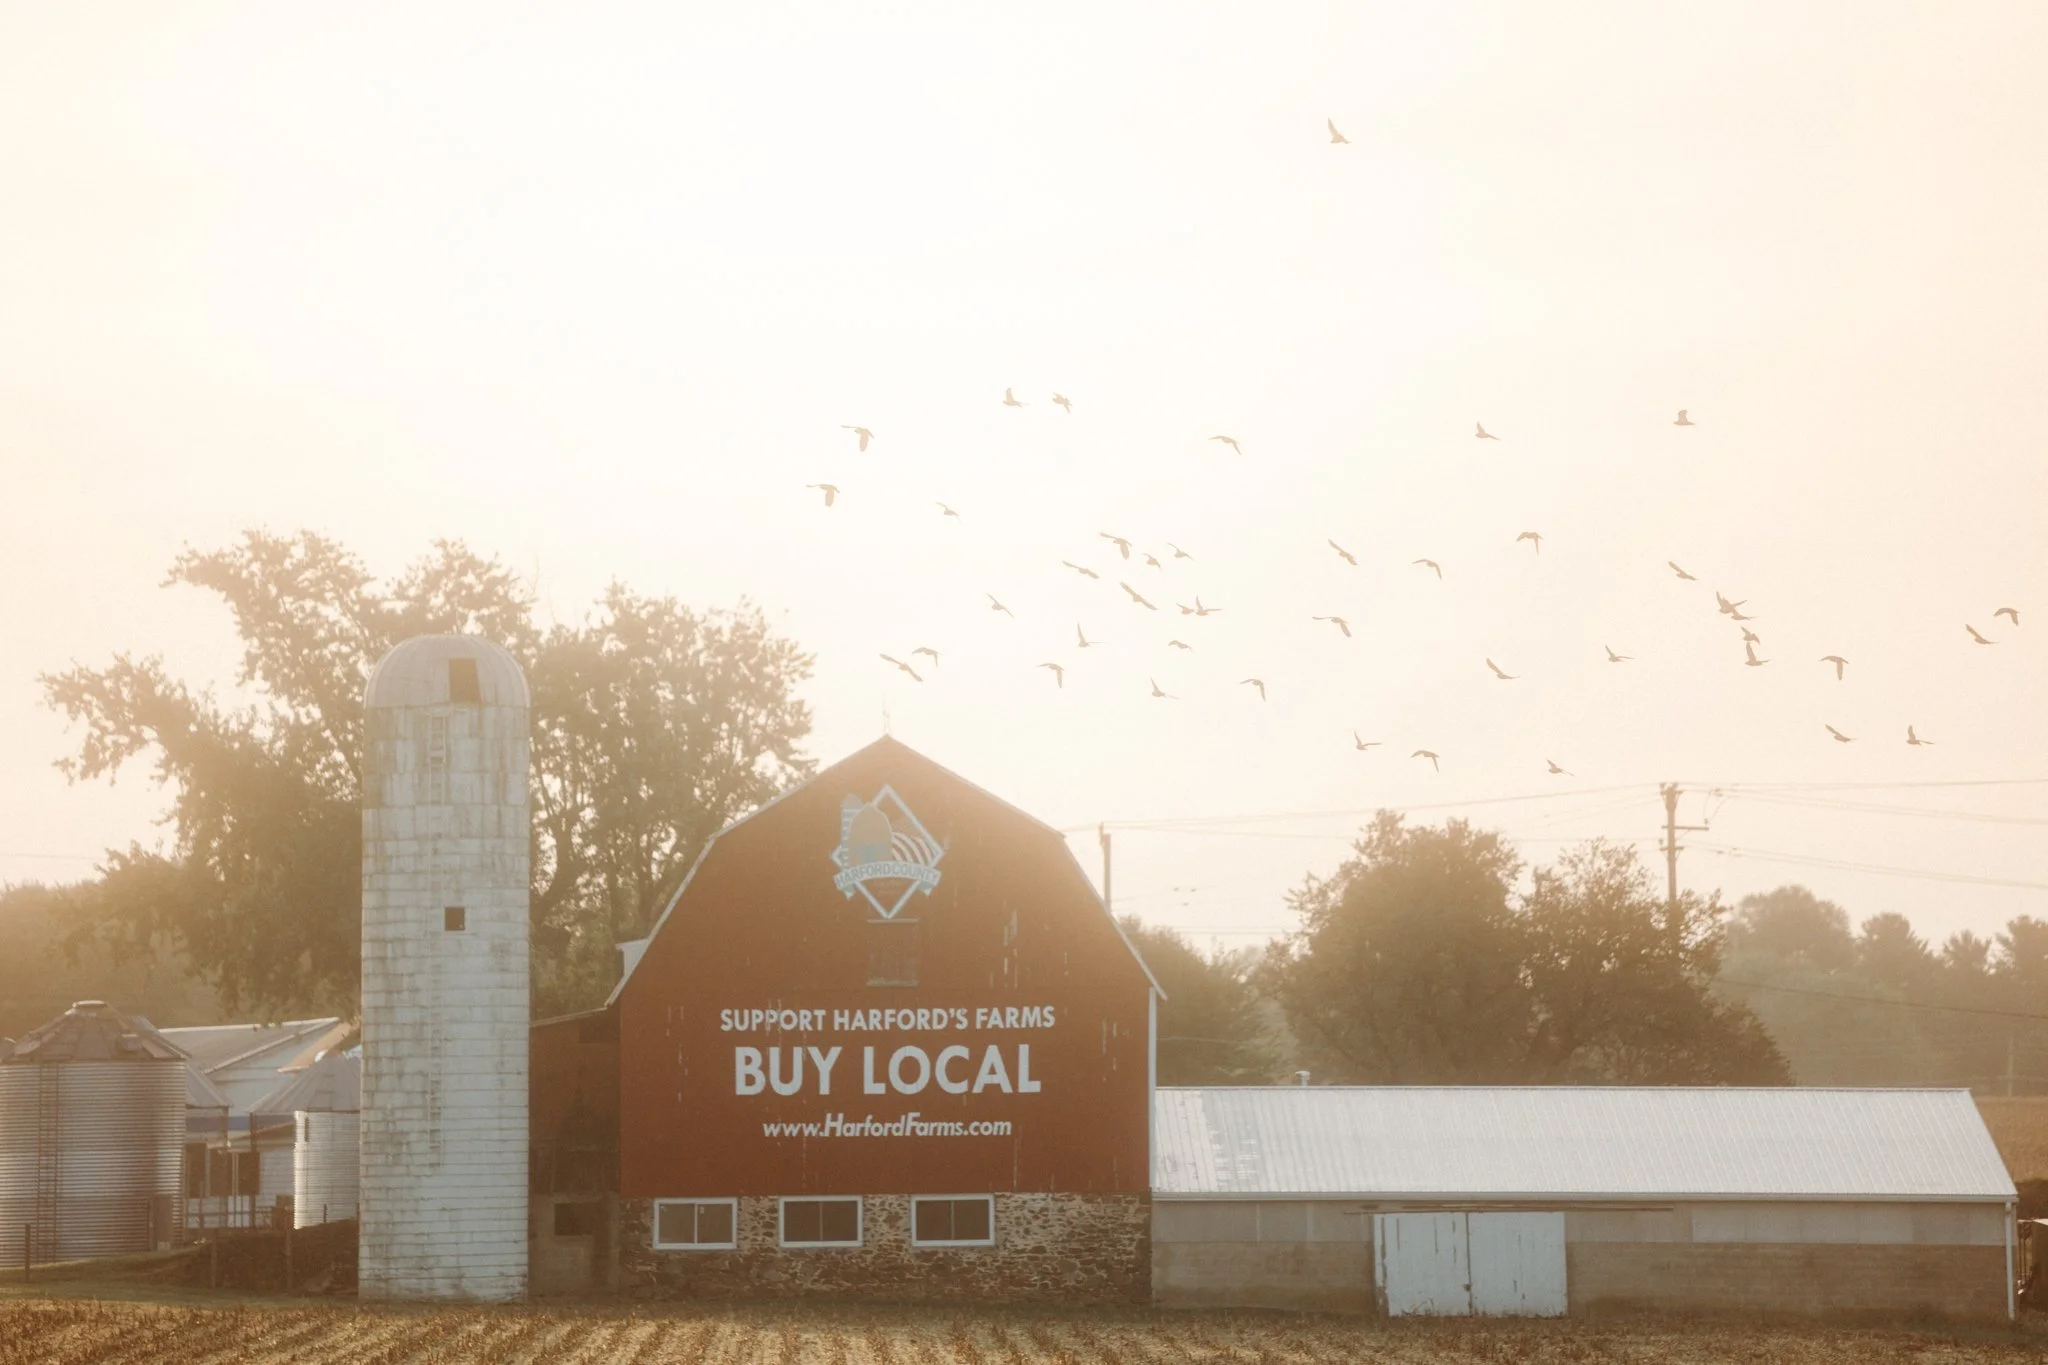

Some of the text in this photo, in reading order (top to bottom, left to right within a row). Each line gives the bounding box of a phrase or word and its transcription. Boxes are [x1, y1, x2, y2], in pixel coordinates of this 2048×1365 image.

[836, 863, 938, 888] HARFORD COUNTY
[720, 1006, 1056, 1031] SUPPORT HARFORD'S FARMS
[735, 1044, 1041, 1096] BUY LOCAL
[763, 1112, 1012, 1137] www.HarfordFarms.com
